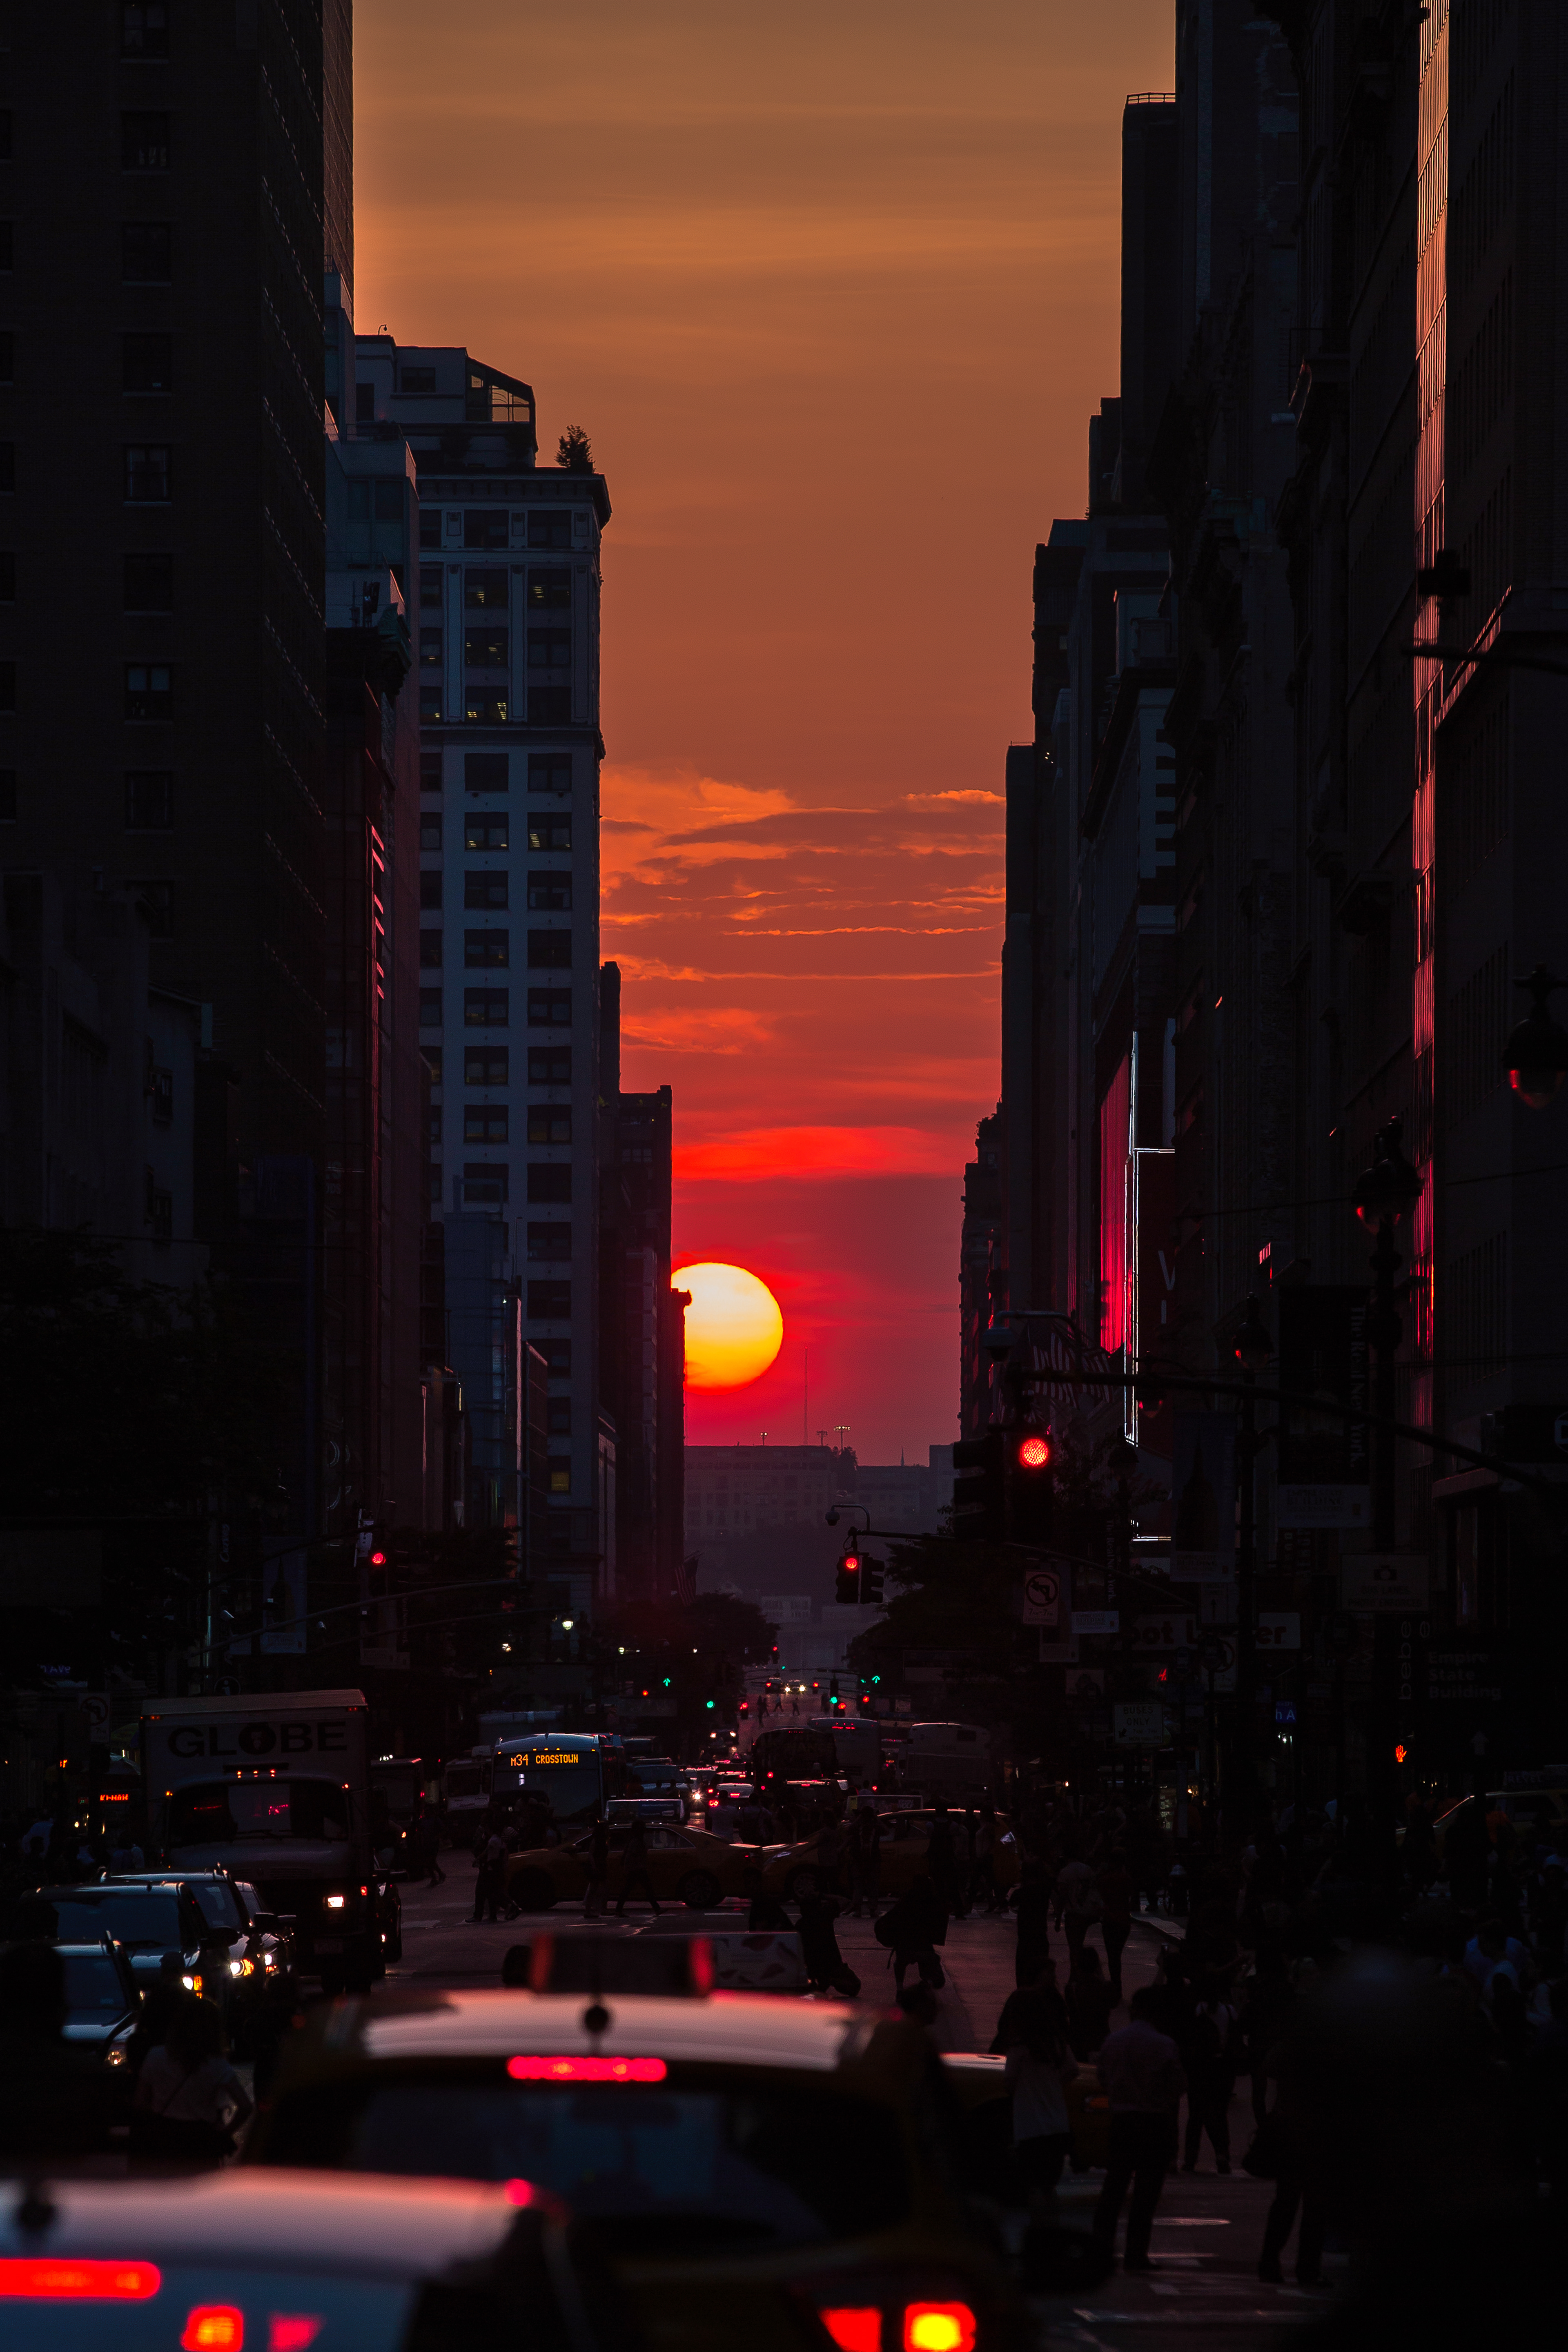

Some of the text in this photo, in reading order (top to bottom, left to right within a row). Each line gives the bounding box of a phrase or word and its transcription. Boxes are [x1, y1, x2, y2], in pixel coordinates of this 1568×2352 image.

[1350, 1305, 1366, 1337] The
[1350, 1341, 1366, 1379] Real
[1361, 1586, 1379, 1594] BUS
[1428, 1650, 1489, 1666] Empire
[1428, 1668, 1476, 1682] State
[1428, 1684, 1502, 1701] Building
[1123, 1706, 1153, 1715] BUSES
[1126, 1717, 1150, 1726] ONLY
[167, 1721, 347, 1758] GLOBE
[510, 1753, 579, 1766] M34 CROSSTOWN
